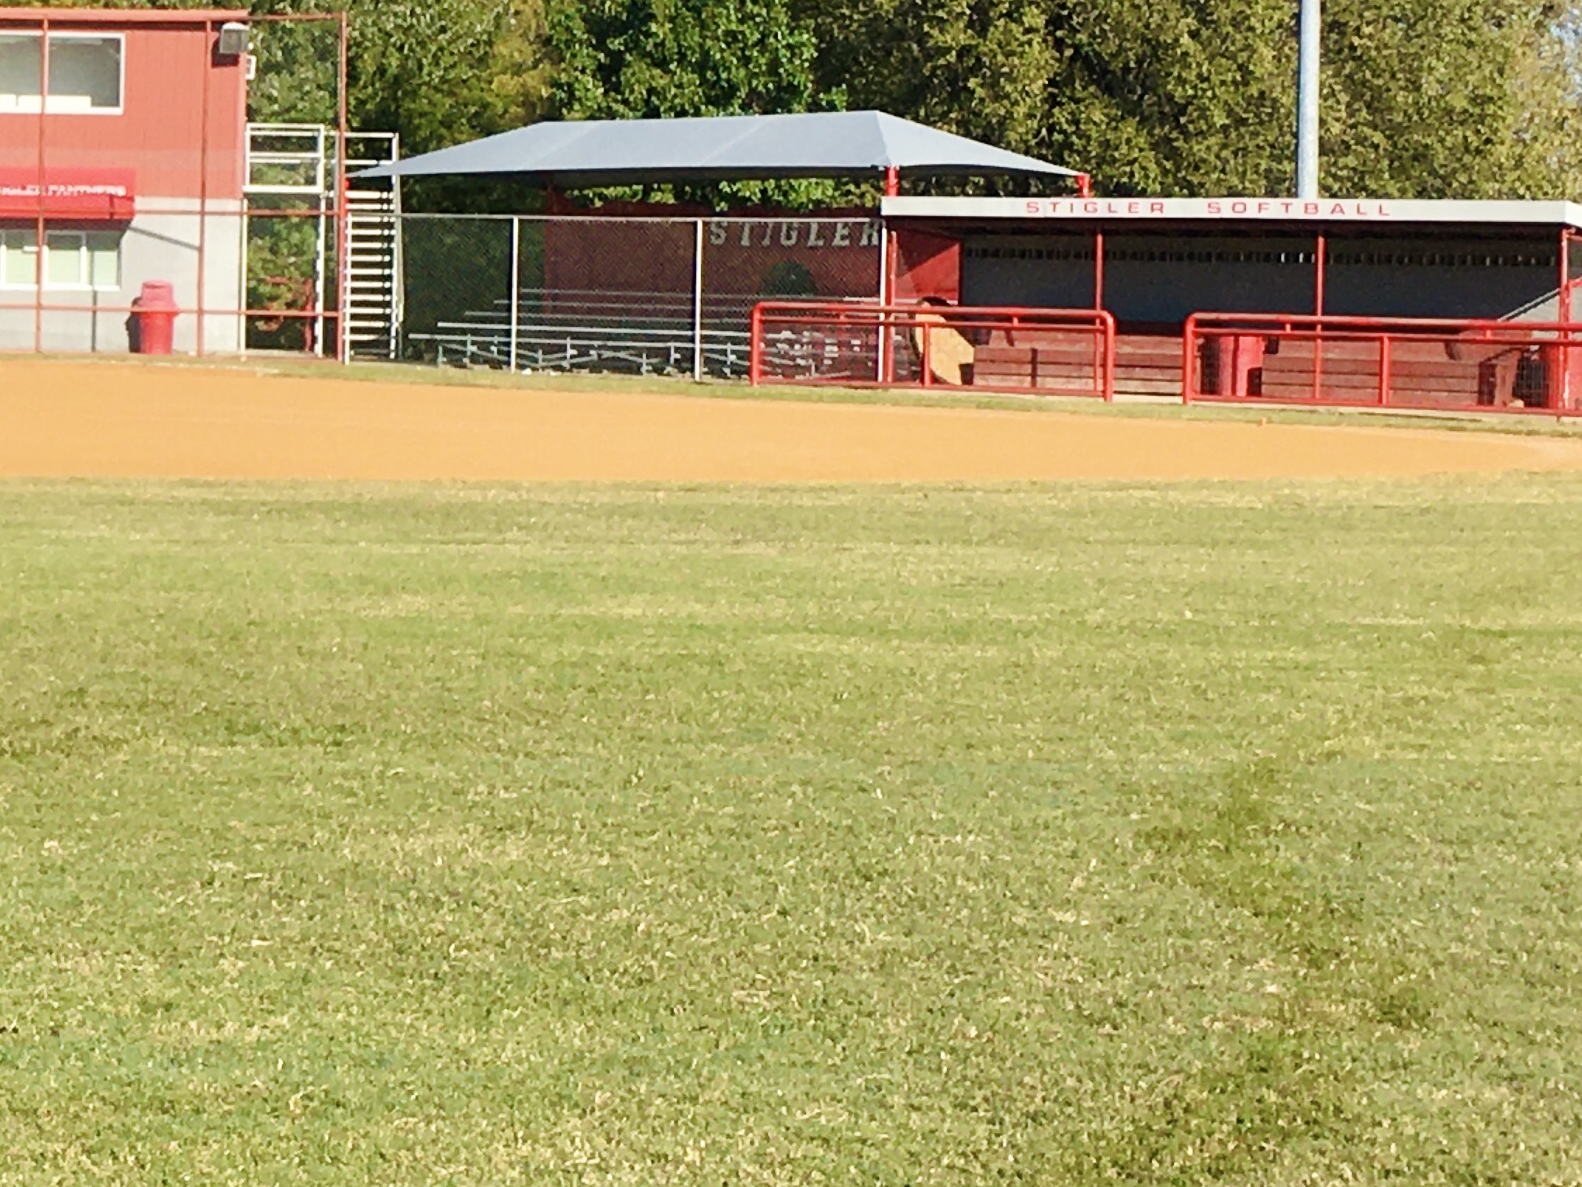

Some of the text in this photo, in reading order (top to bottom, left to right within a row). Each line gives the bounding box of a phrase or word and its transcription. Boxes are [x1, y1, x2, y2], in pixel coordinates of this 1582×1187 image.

[1026, 200, 1391, 216] STIGLER SOFTBALL
[709, 219, 884, 247] STIGLER
